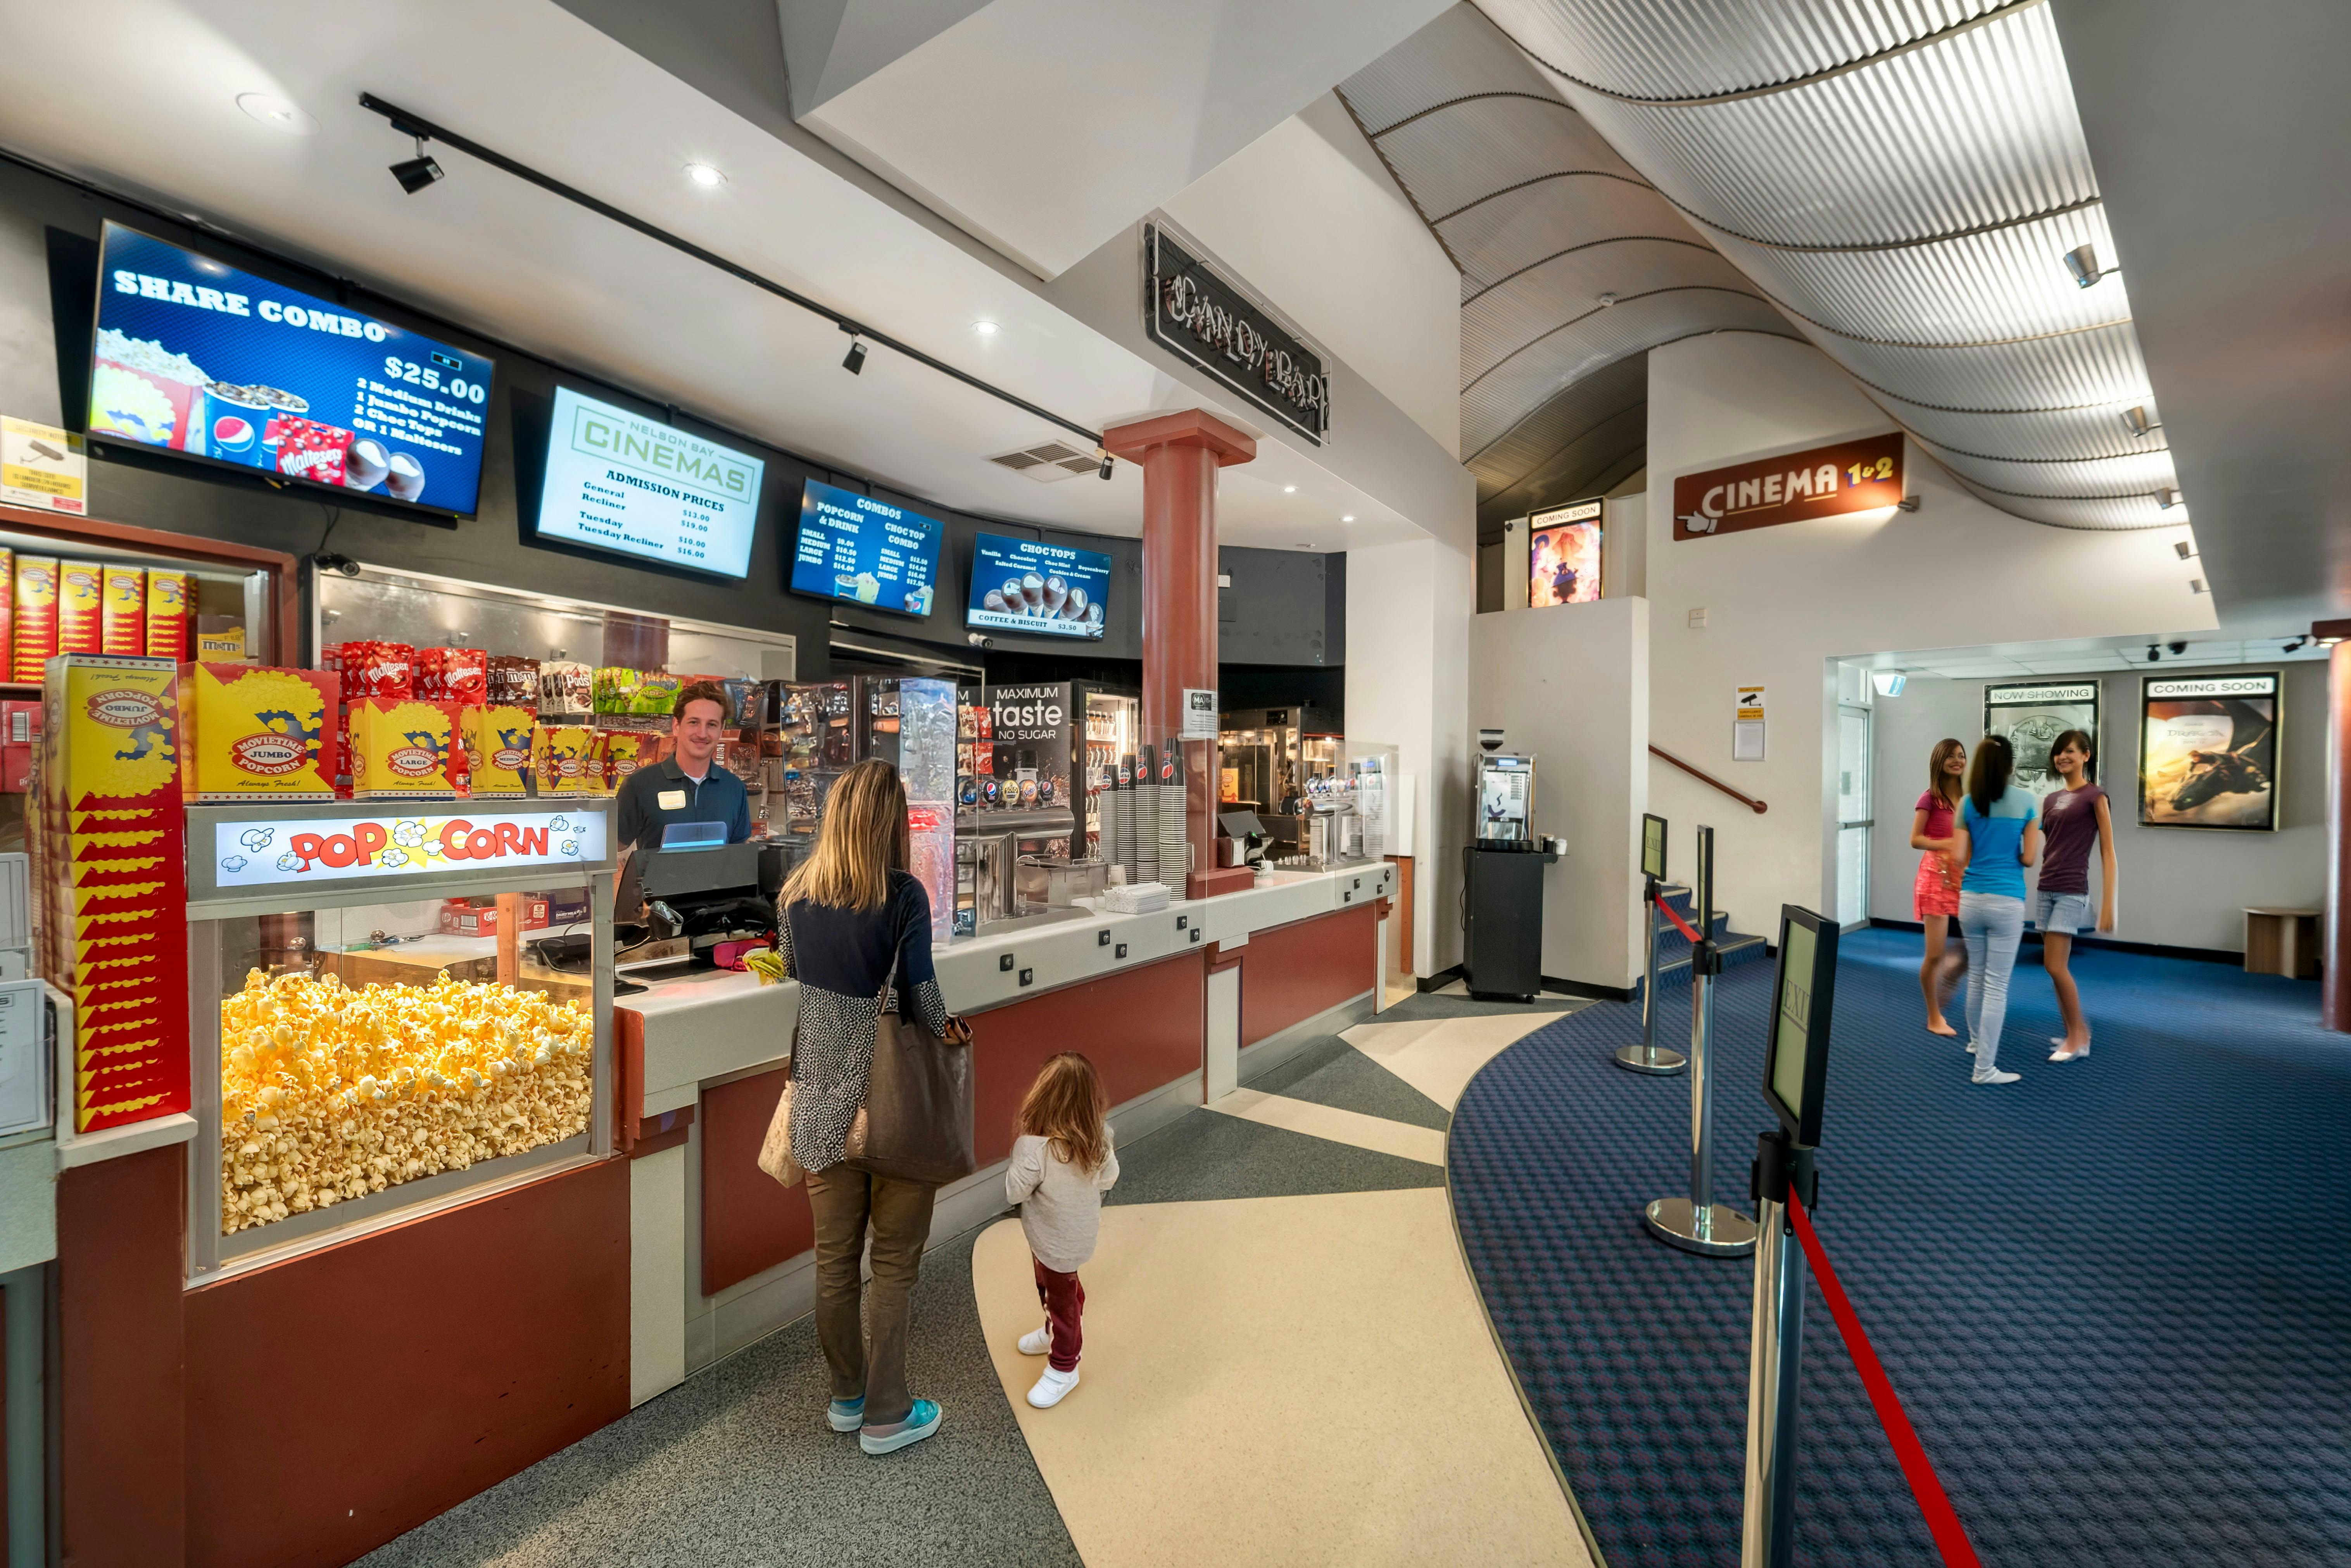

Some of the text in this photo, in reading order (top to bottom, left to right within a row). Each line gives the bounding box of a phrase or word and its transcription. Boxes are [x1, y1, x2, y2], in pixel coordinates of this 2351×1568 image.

[114, 270, 386, 343] SHARE COMBO
[384, 356, 485, 404] $25.00
[357, 378, 482, 424] 2 Medium Drinks
[354, 404, 443, 439] 2 Choc Tops
[357, 391, 482, 437] 1 Jumbo Popcorn
[352, 417, 462, 455] OR 1 Maltesers
[630, 421, 714, 457] NELSON BAY
[279, 448, 343, 476] Maltesers
[584, 420, 745, 493] CINEMAS
[19, 474, 41, 484] UNDER
[50, 481, 71, 490] HOURS
[20, 481, 64, 495] SURVEILLANCE
[584, 481, 625, 499] General
[606, 470, 725, 512] ADMISSION PRICES
[1702, 464, 1838, 518] CINEMA
[582, 493, 626, 511] Recliner
[856, 498, 902, 520] COMBOS
[580, 511, 623, 529] Tuesday
[683, 509, 710, 523] $13.00
[817, 501, 865, 523] POPCORN
[1536, 506, 1597, 525] COMING SOON
[681, 519, 708, 533] $19.00
[819, 515, 860, 534] & DRINK
[884, 522, 925, 541] CHOC TOP
[578, 523, 664, 549] Tuesday Recliner
[679, 536, 706, 549] $10.00
[801, 528, 855, 548] SMALL $9.00
[888, 535, 919, 550] COMBO
[677, 547, 705, 559] $16.00
[799, 545, 856, 565] LARGE $12.50
[800, 537, 857, 557] MEDIUM $10.50
[1020, 543, 1076, 560] CHOC TOPS
[798, 553, 855, 573] JUMBO $14.00
[879, 555, 927, 573] MEDIUM $14.00
[880, 548, 928, 566] SMALL $12.50
[981, 549, 1001, 558] Vanilla
[1010, 554, 1037, 563] Chocolate
[1078, 565, 1110, 575] Boysenberry
[878, 563, 926, 580] LARGE $16.00
[995, 560, 1012, 569] Salted
[1013, 563, 1037, 571] Caramel
[1049, 568, 1070, 576] Cookies
[877, 571, 925, 587] JUMBO $17.50
[978, 614, 1009, 624] COFFEE
[1017, 619, 1048, 628] BISCUIT
[90, 673, 159, 683] Always Fresh!
[368, 661, 409, 683] Maltesers
[444, 666, 482, 688] Maltesers
[566, 673, 590, 688] Pods
[996, 687, 1058, 699] MAXIMUM
[1994, 689, 2090, 700] NOW SHOWING
[2154, 681, 2267, 694] COMING SOON
[95, 691, 159, 707] POPCORN
[92, 711, 161, 725] MOVIETIME
[961, 712, 975, 722] Pods
[993, 700, 1063, 726] taste
[999, 730, 1056, 740] NO SUGAR
[236, 736, 306, 754] MOVIETIME
[494, 750, 526, 758] MOVIETIME
[390, 749, 437, 762] MOVIETIME
[238, 757, 301, 774] POPCORN
[392, 765, 435, 776] POPCORN
[494, 761, 523, 769] POPCORN
[273, 779, 301, 787] Fresh!
[290, 818, 549, 873] POP CORN
